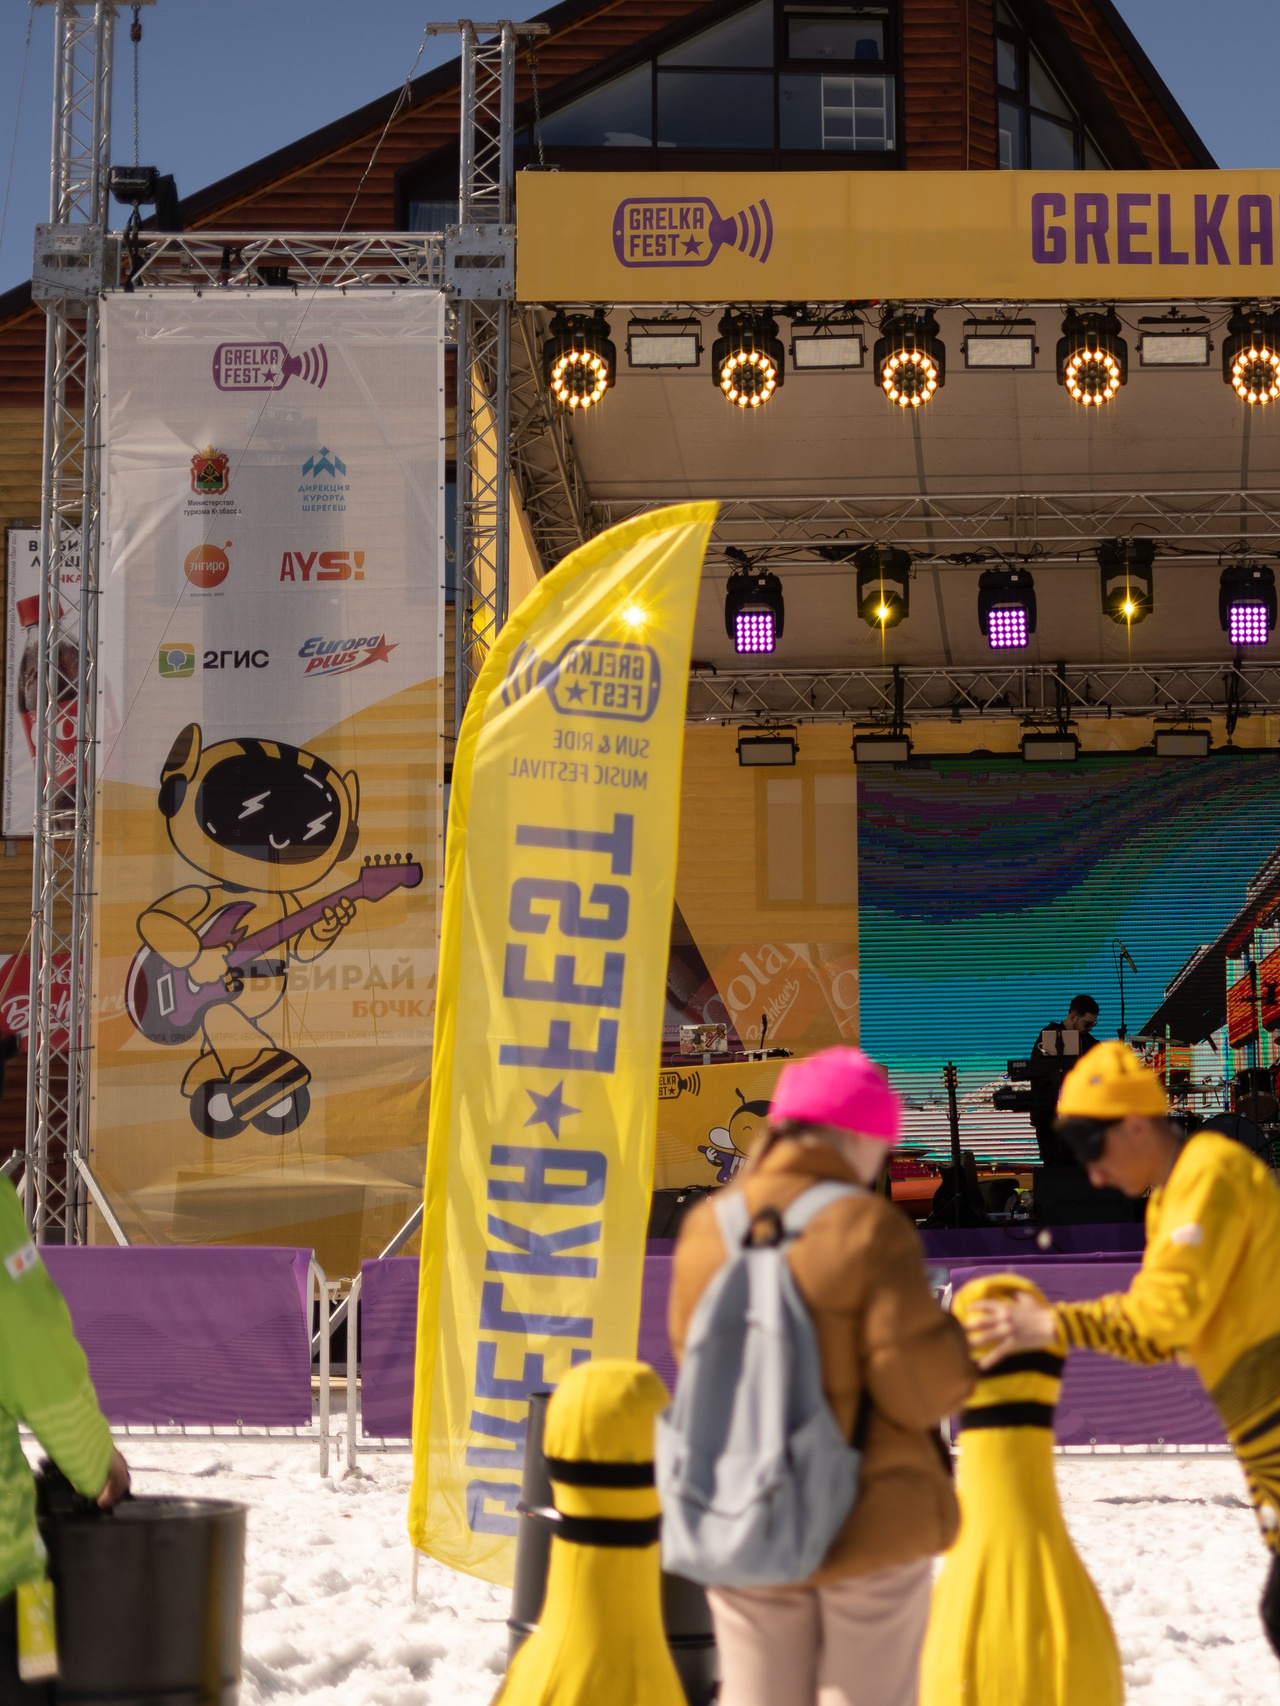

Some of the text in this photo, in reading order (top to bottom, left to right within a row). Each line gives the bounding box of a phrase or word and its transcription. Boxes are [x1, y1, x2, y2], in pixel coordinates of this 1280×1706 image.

[628, 207, 704, 232] GRELKA
[630, 232, 682, 258] FEST
[224, 349, 279, 366] GRELKA
[224, 367, 261, 384] FEST
[298, 484, 350, 493] ДИРЕКЦИЯ
[187, 499, 235, 508] Министерство
[302, 494, 345, 502] КУРОРТА
[302, 504, 346, 512] ШЕРЕГЕШ
[189, 560, 226, 574] энгиро
[279, 550, 366, 582] AYS!
[202, 649, 270, 669] 2ГИС
